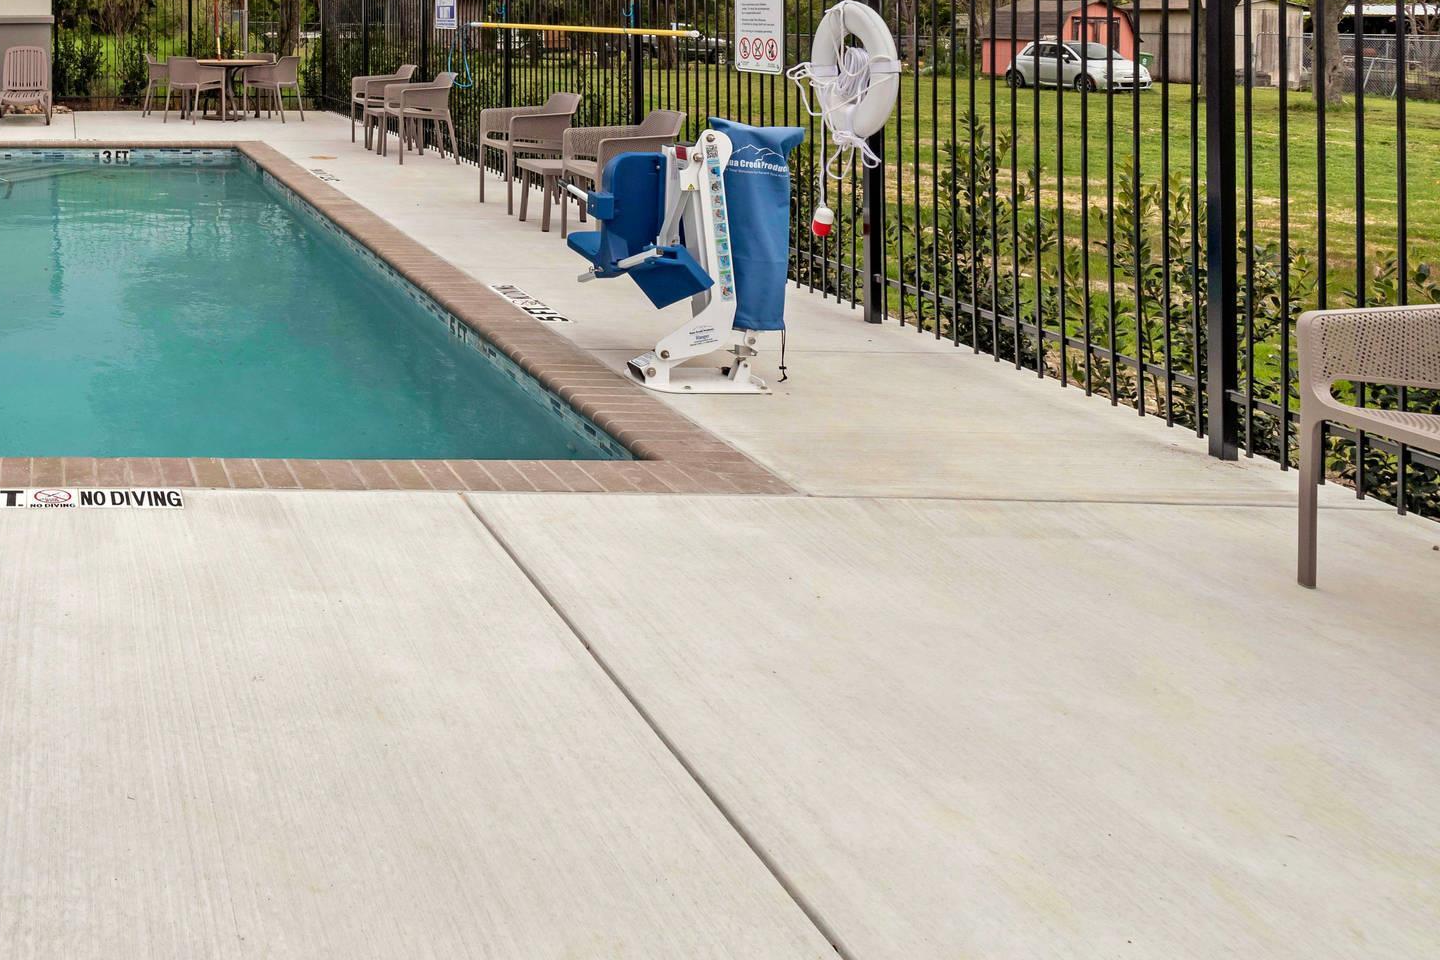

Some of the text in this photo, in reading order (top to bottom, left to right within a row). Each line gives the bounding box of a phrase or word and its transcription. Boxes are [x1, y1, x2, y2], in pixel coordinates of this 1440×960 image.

[102, 150, 129, 164] 3 FT
[740, 159, 761, 168] Creek
[80, 491, 106, 506] NO
[110, 491, 183, 507] DIVING
